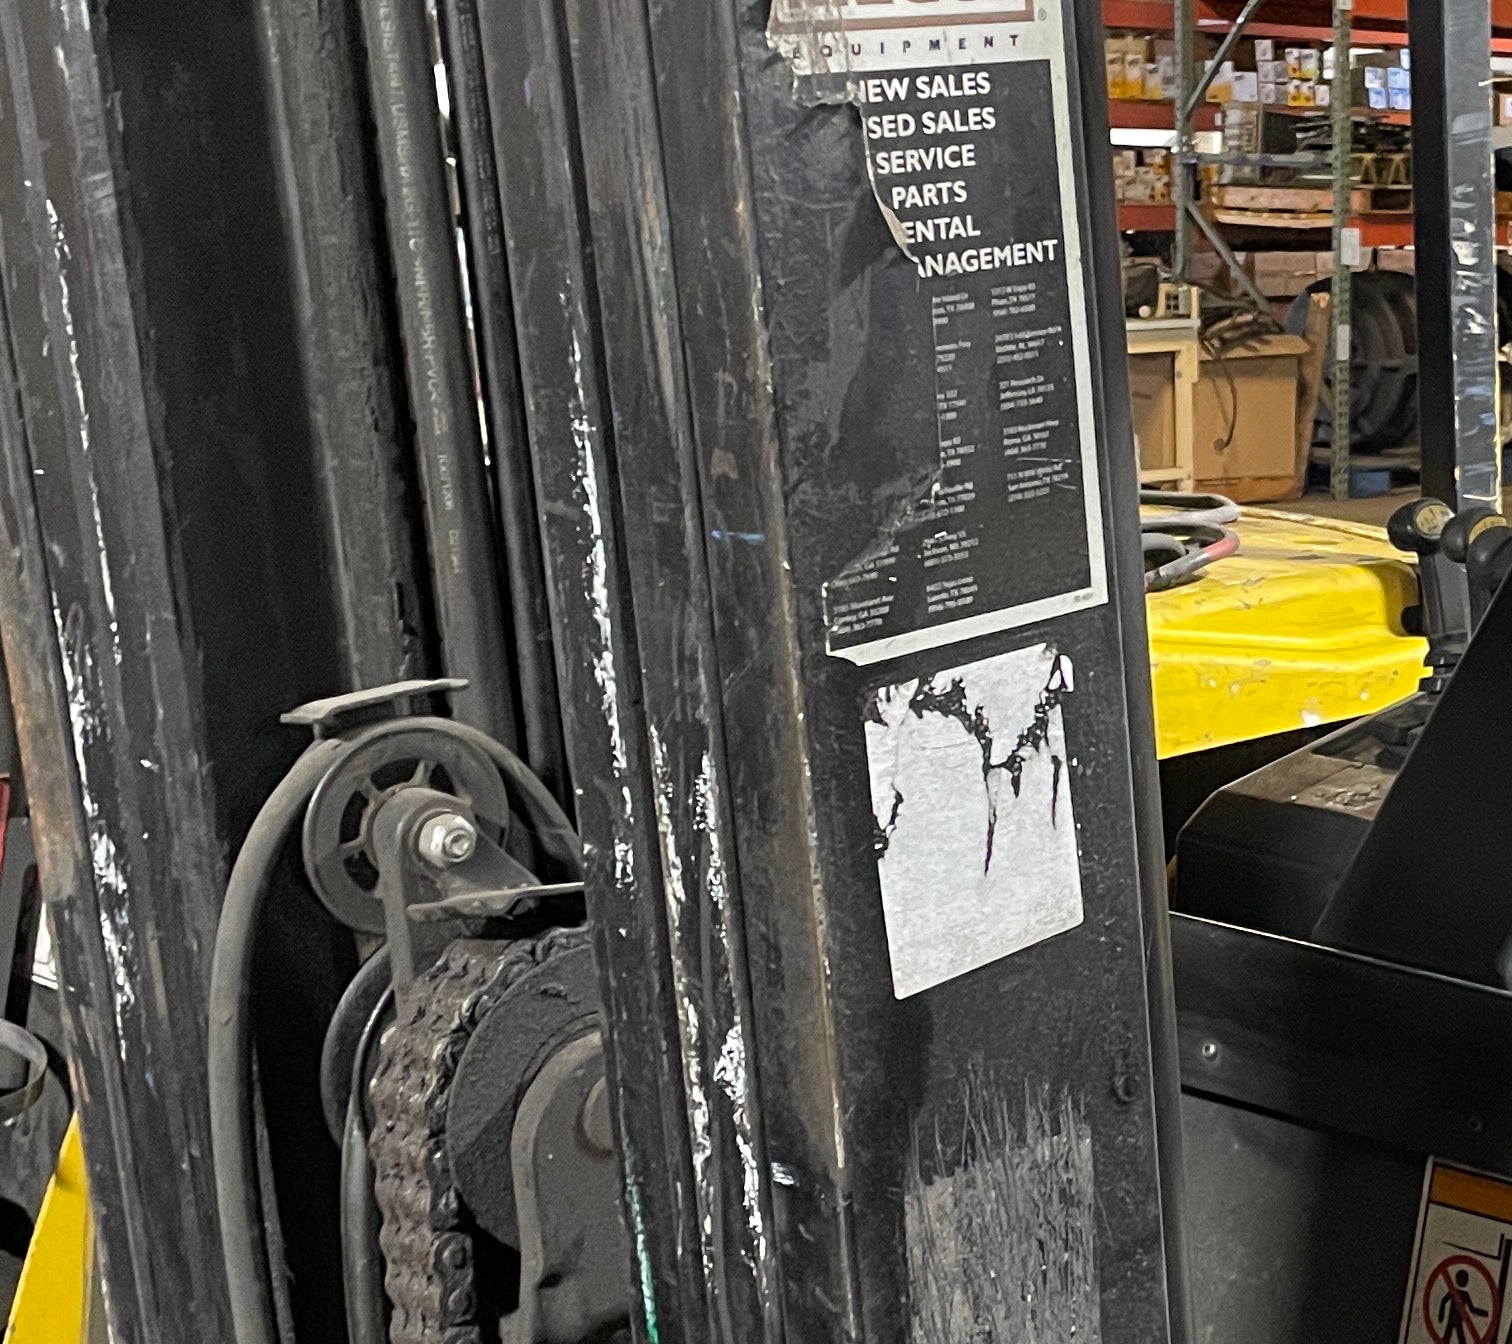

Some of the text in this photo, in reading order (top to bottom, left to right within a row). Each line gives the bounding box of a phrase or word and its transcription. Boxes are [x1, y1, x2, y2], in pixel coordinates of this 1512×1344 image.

[915, 71, 991, 99] SALES
[864, 106, 997, 139] SED SALES
[876, 144, 977, 175] SERVICE
[891, 180, 968, 210] PARTS
[900, 215, 981, 245] ENTAL
